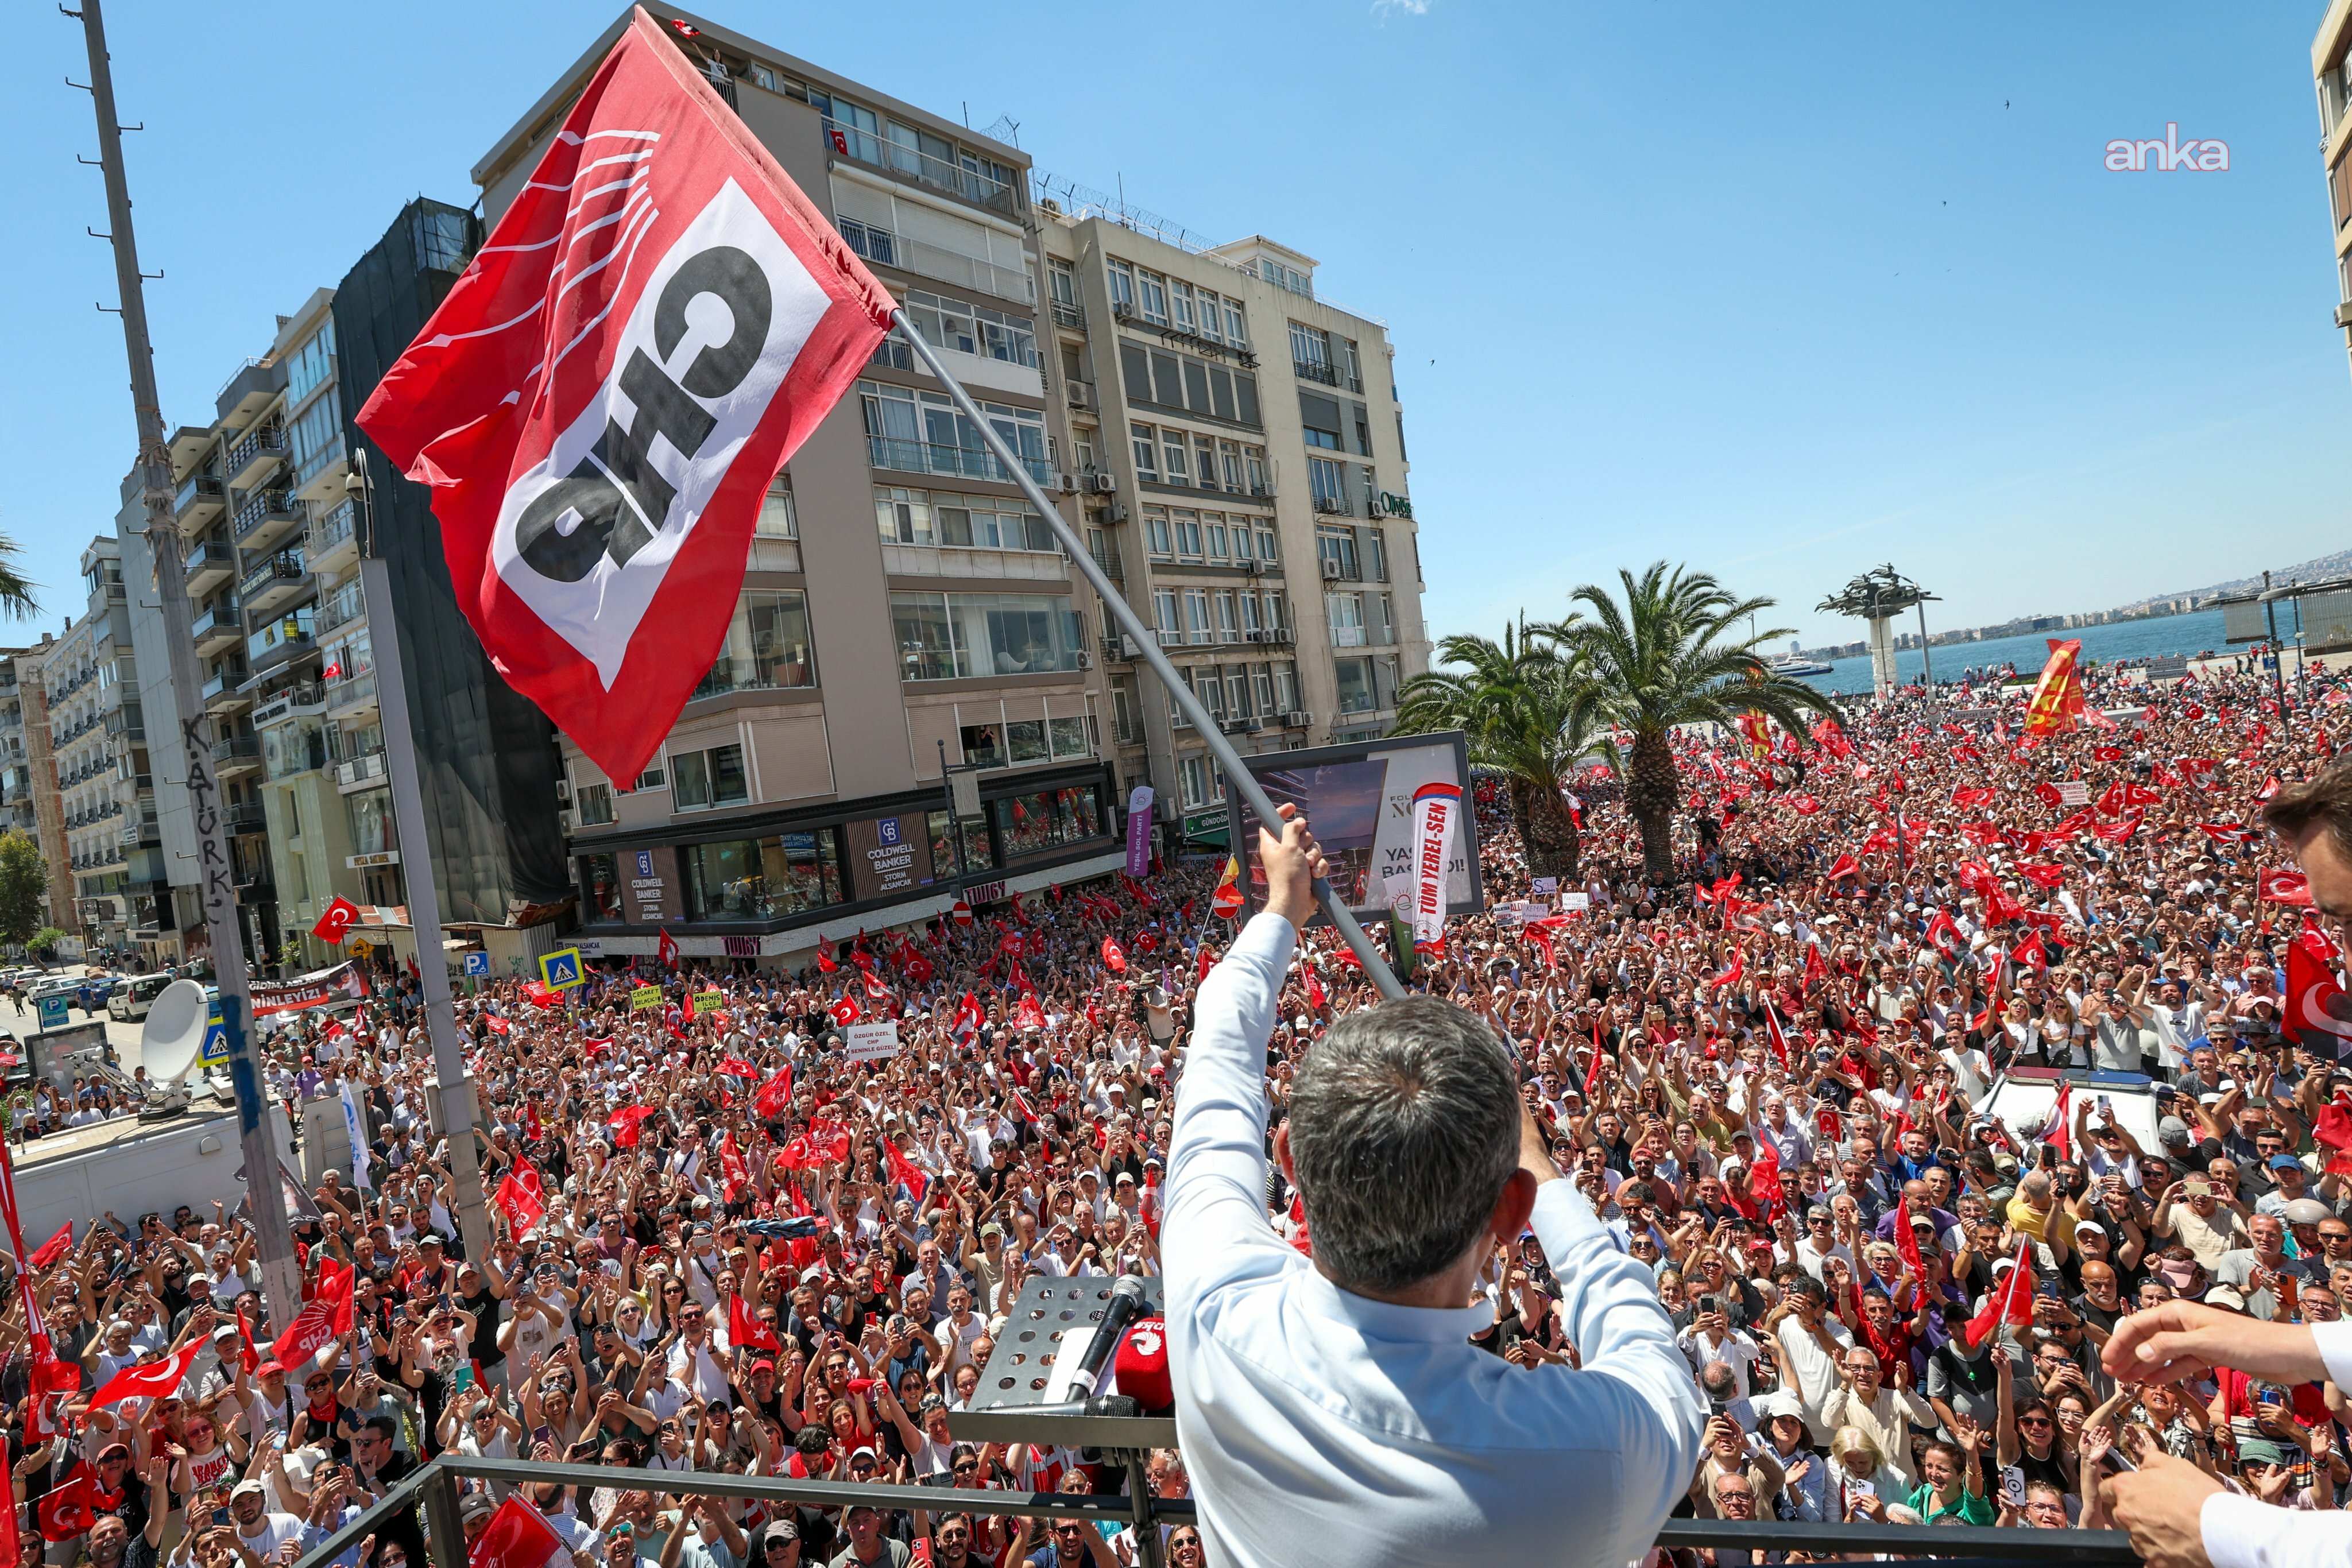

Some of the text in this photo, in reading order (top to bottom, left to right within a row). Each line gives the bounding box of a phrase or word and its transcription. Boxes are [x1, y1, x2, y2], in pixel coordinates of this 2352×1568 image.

[1202, 815, 1228, 827] GÜNDOĞD
[1422, 802, 1447, 882] YEREL-SEN
[867, 843, 915, 860] COLDWELL
[875, 854, 912, 870] BANKER
[884, 871, 907, 882] STORM
[632, 878, 664, 888] COLDWELL
[880, 878, 912, 891] ALSANCAK
[636, 889, 662, 899] BANKER
[1418, 886, 1438, 915] TÜM
[466, 955, 481, 974] P
[247, 981, 283, 991] ĞİDİM,
[250, 988, 322, 1009] NİNLEYİZ!
[633, 988, 659, 998] CESARET
[48, 1000, 59, 1010] P
[488, 1021, 501, 1029] CHP
[807, 1148, 831, 1157] CHP
[1134, 1321, 1165, 1331] nka
